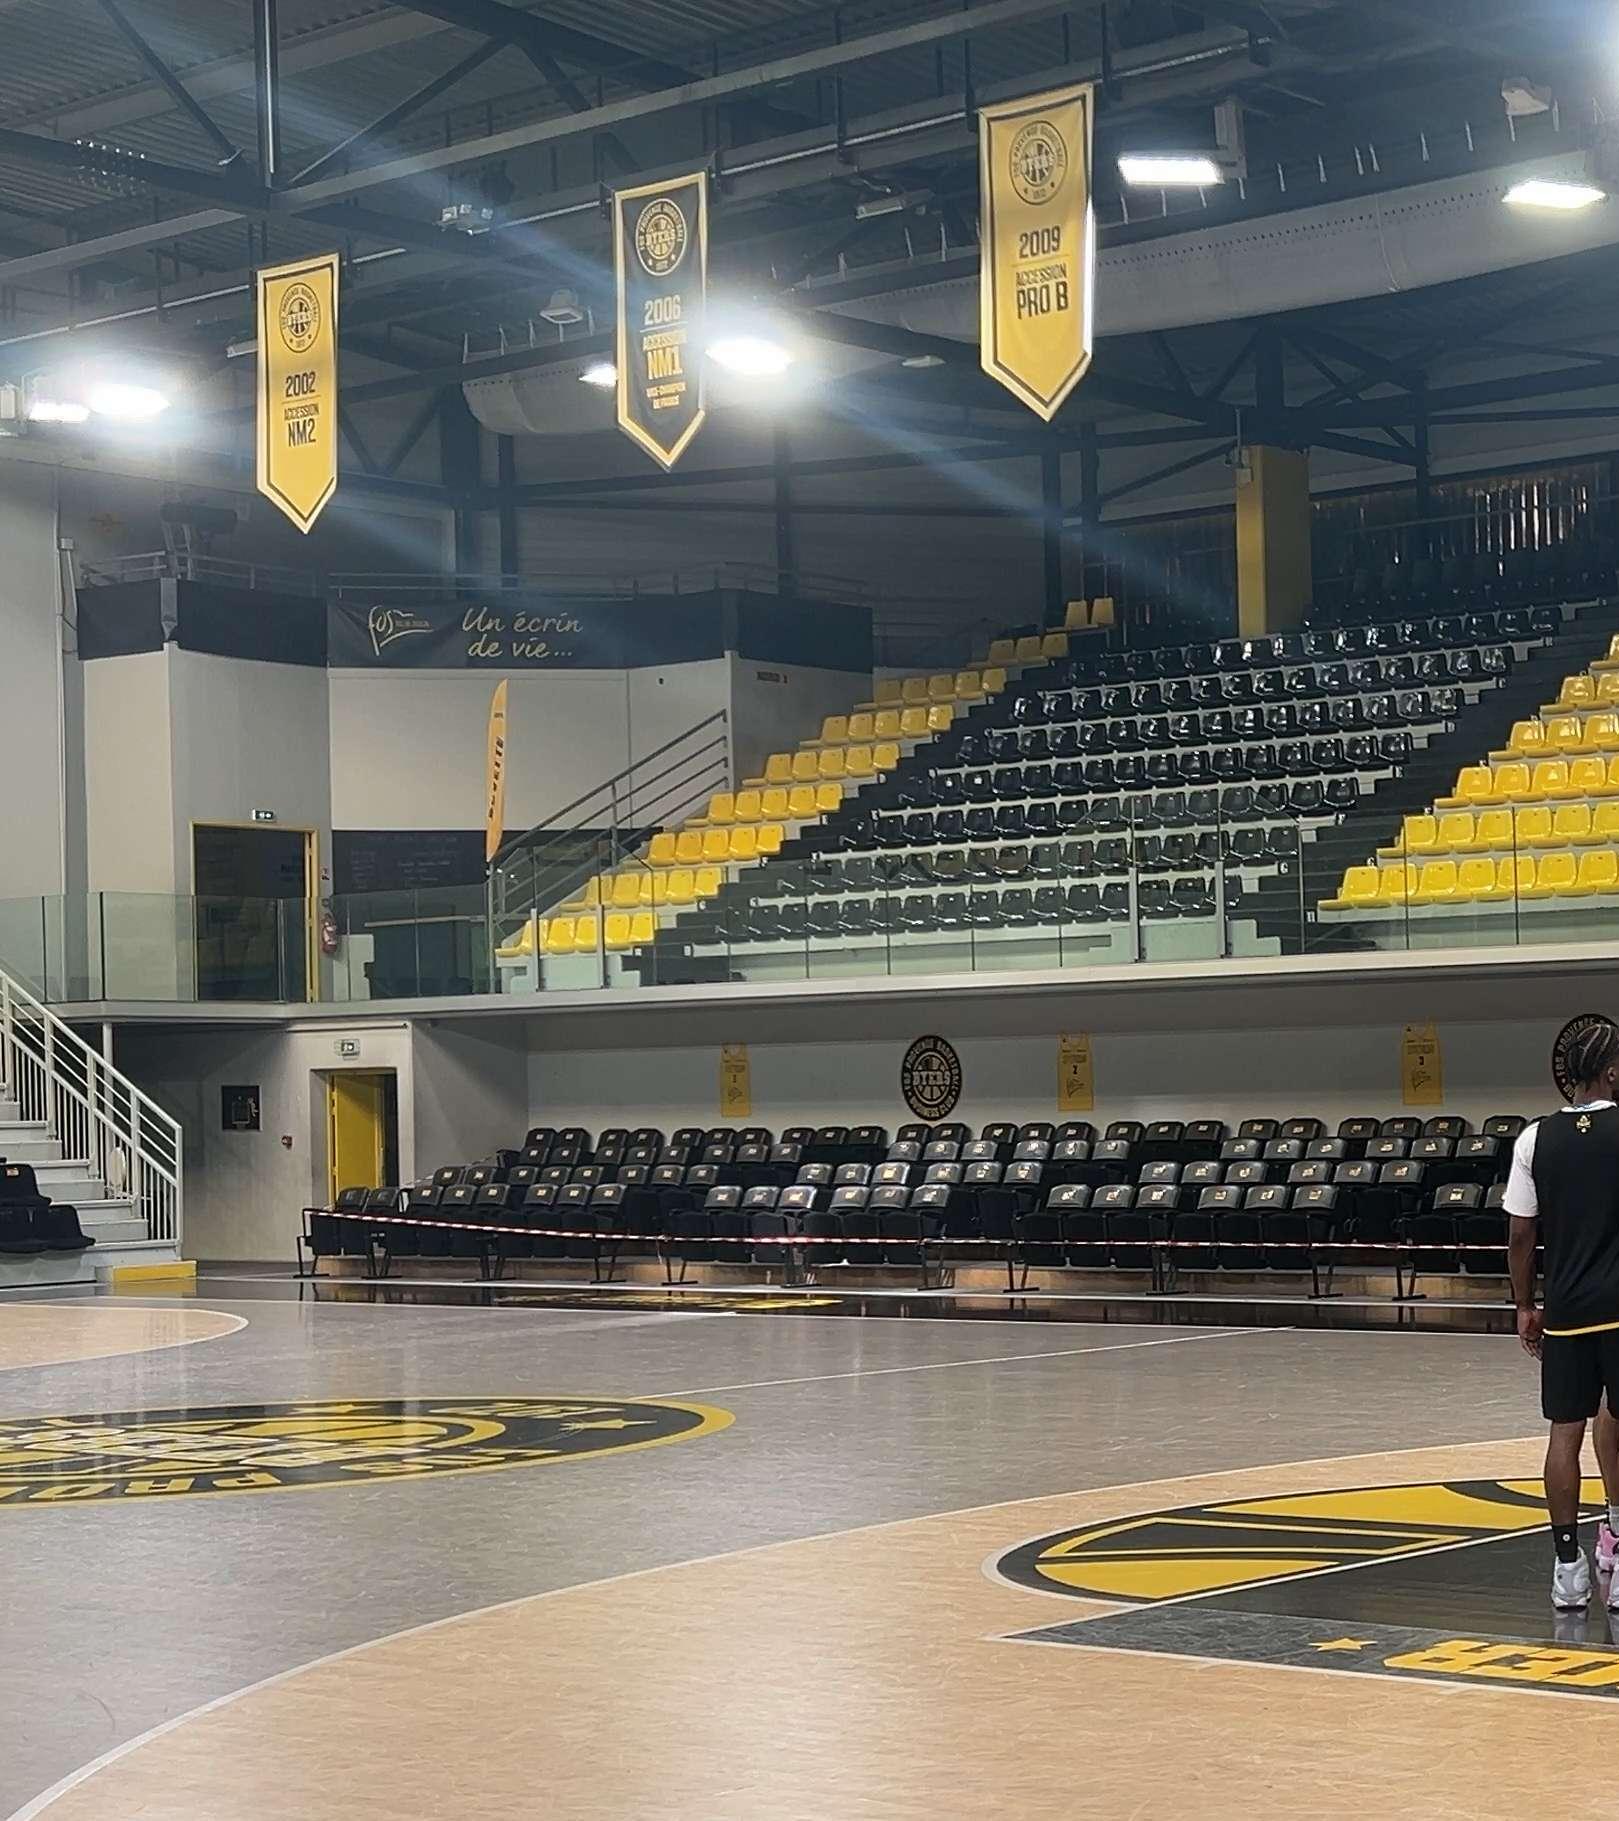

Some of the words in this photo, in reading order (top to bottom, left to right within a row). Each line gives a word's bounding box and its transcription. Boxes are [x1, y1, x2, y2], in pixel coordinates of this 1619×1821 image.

[1018, 225, 1061, 259] 2009
[644, 294, 681, 326] 2006
[1016, 284, 1051, 320] PRO
[1056, 280, 1069, 312] B
[647, 345, 684, 381] NM1
[285, 371, 317, 398] 2002
[287, 418, 317, 448] NM2
[461, 606, 505, 633] Un
[513, 611, 584, 633] écrin
[467, 633, 502, 658] de
[912, 1070, 951, 1086] BYERS
[340, 1448, 561, 1475] FOS
